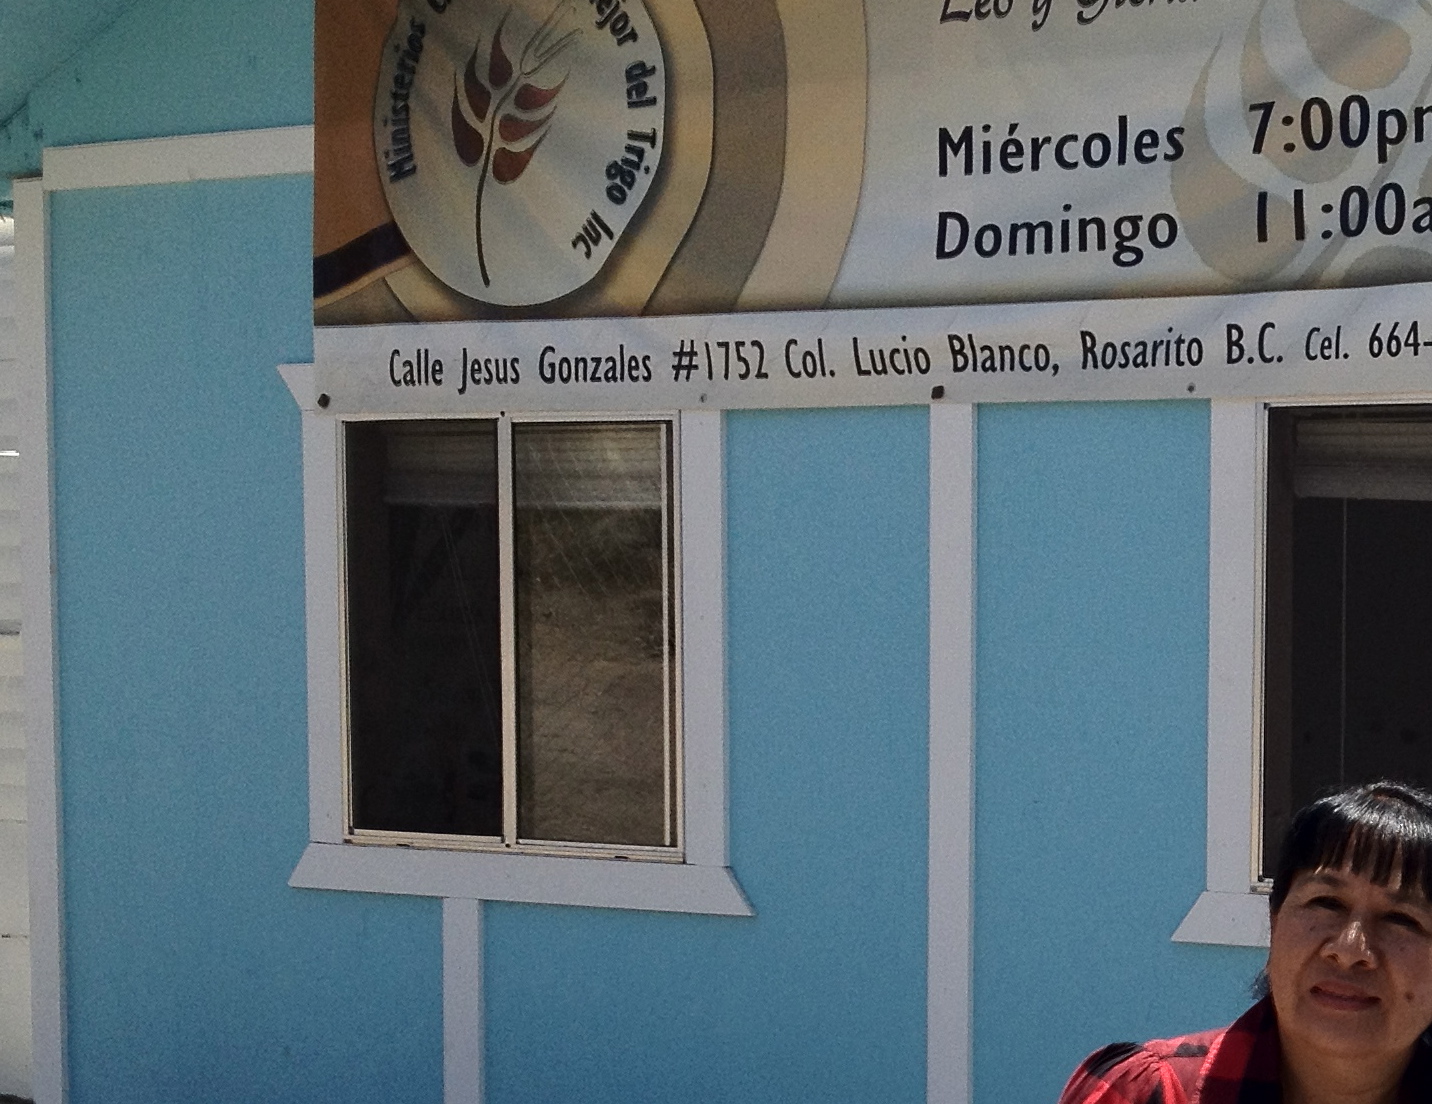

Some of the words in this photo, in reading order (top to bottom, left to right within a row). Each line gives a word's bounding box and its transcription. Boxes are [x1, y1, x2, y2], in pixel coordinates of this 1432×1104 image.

[590, 0, 638, 47] ejor
[384, 16, 426, 183] Ministerios
[625, 60, 657, 109] del
[605, 127, 658, 206] Trigo
[937, 114, 1186, 178] Miércoles
[571, 209, 614, 260] Inc
[935, 203, 1178, 268] Domingo
[389, 348, 444, 388] Calle
[457, 347, 521, 396] Jesus
[538, 343, 652, 385] Gonzales
[671, 339, 769, 383] #1752
[784, 337, 836, 379] Col.
[852, 334, 932, 377] Lucio
[947, 333, 1060, 377] Blanco,
[1079, 326, 1204, 371] Rosarito
[1226, 321, 1284, 365] B.C.
[1304, 325, 1350, 361] Cel.
